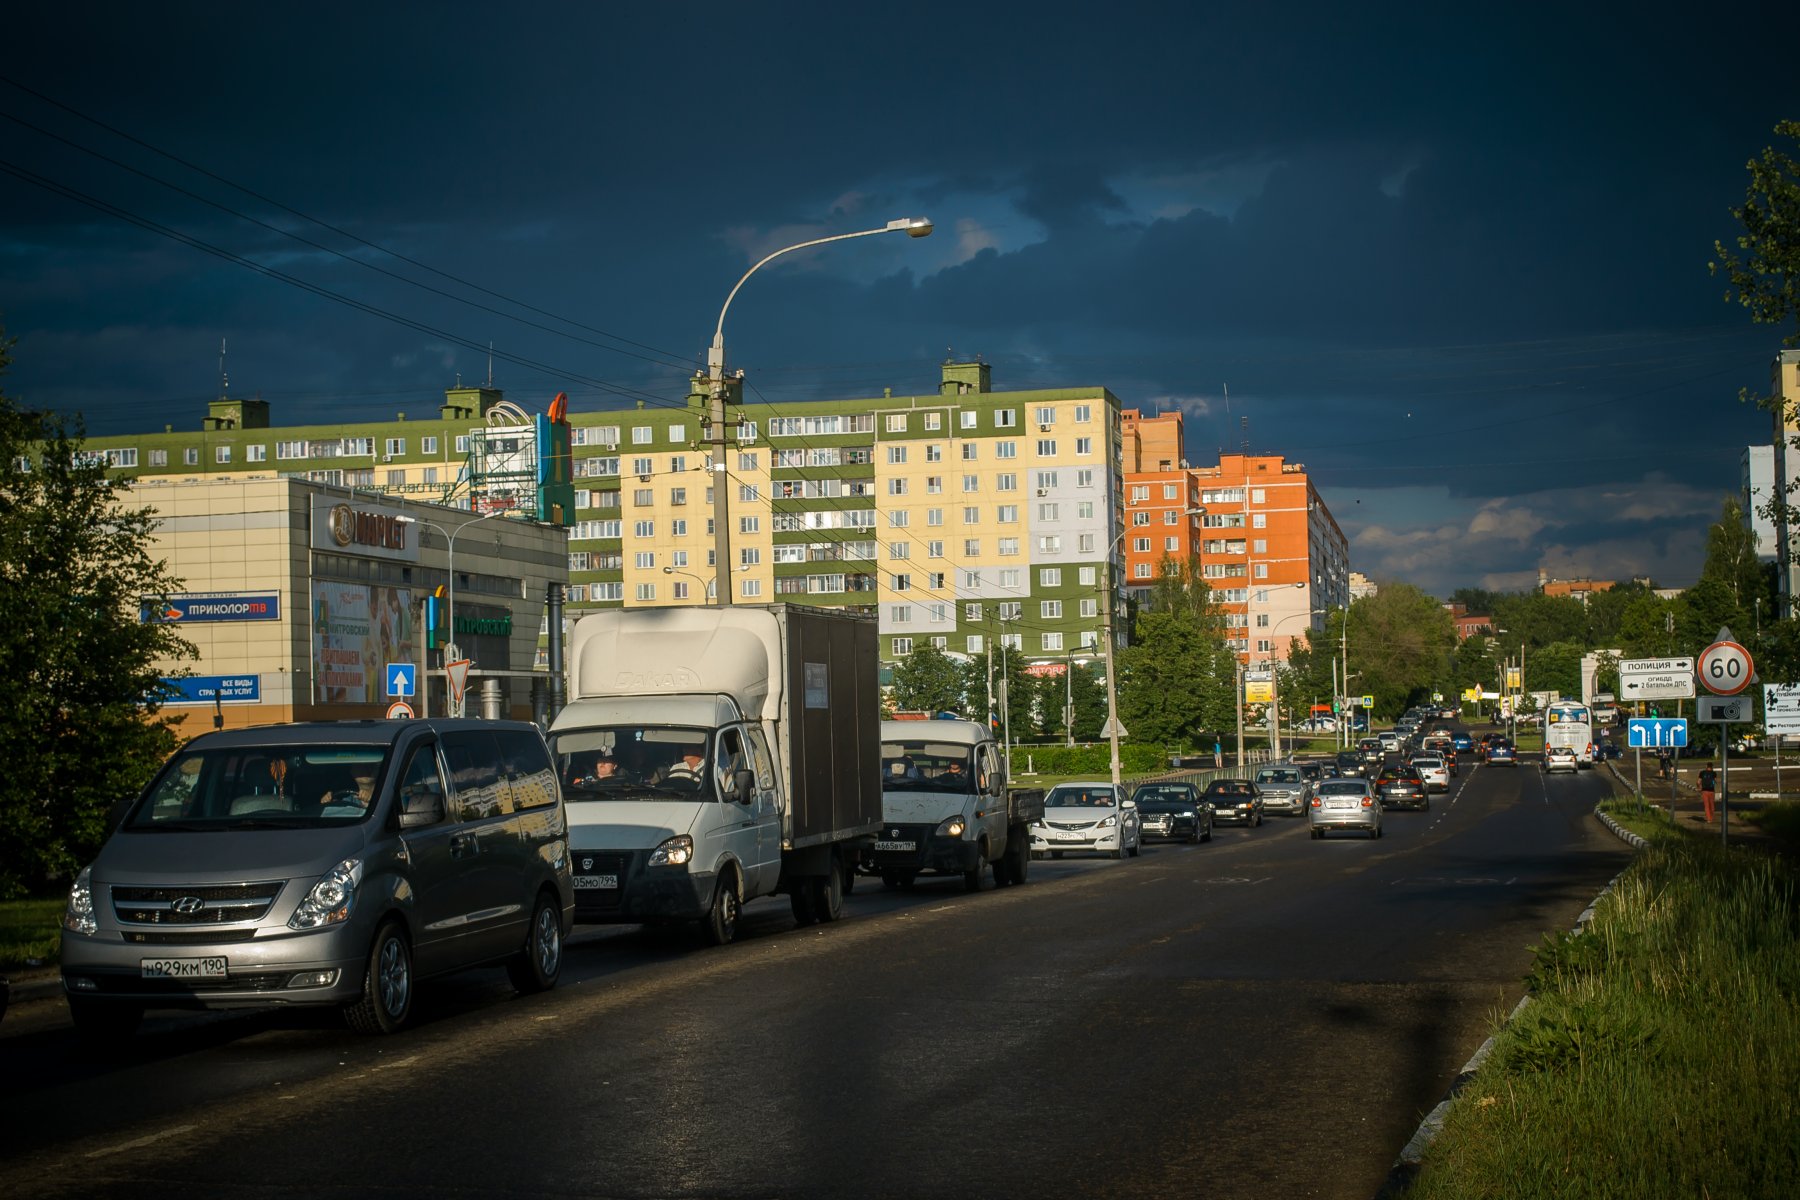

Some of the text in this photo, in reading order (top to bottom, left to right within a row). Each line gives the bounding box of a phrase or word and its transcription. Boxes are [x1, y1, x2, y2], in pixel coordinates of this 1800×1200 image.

[353, 511, 407, 550] МАРКЕТ
[1628, 661, 1671, 670] ПОЛИЦИЯ
[1710, 657, 1740, 678] 60
[234, 679, 253, 687] ВИДЫ
[234, 687, 253, 695] УСЛУГ
[600, 876, 614, 885] 799
[146, 959, 222, 976] Н929КМ 190
